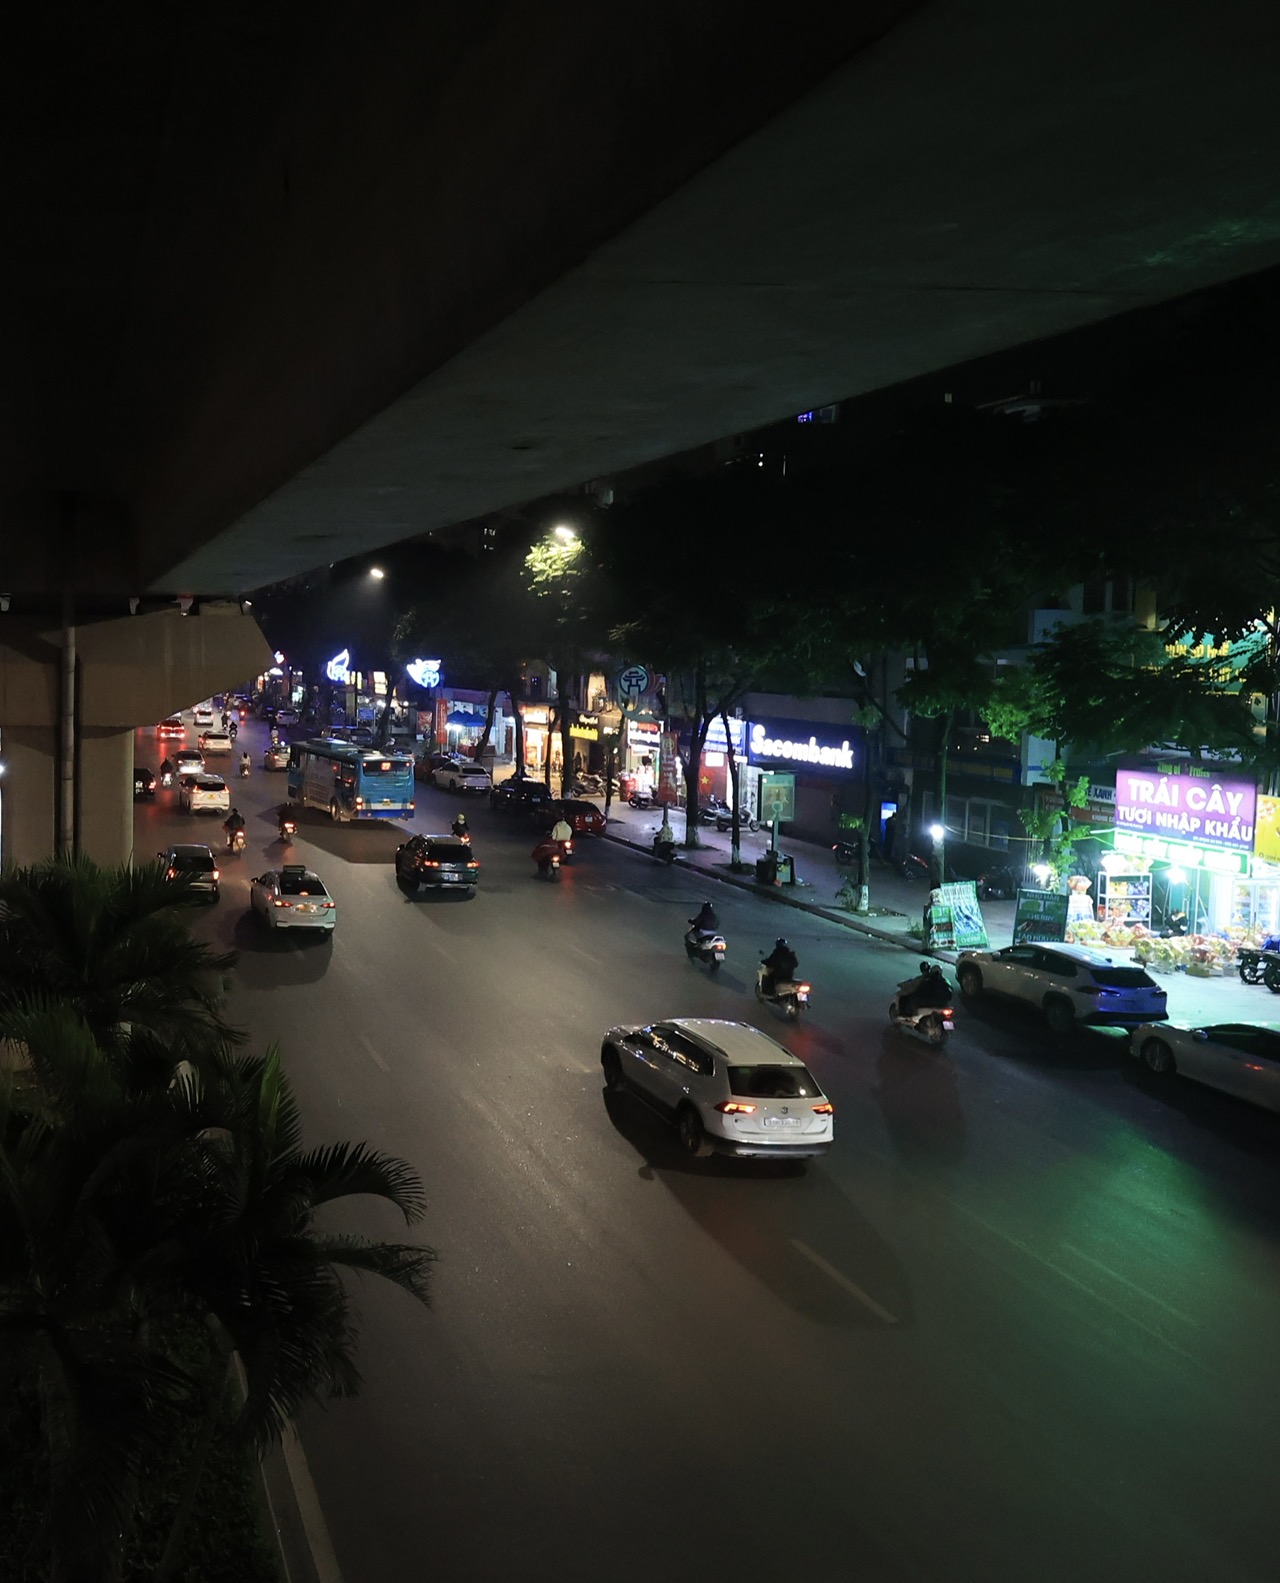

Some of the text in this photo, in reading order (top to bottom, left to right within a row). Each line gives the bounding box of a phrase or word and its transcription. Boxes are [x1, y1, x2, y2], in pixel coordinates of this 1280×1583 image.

[750, 724, 854, 769] Sacombank
[1127, 776, 1244, 816] TRÁI CÂY
[1117, 806, 1253, 842] TƯƠI NHẬP KHẨU
